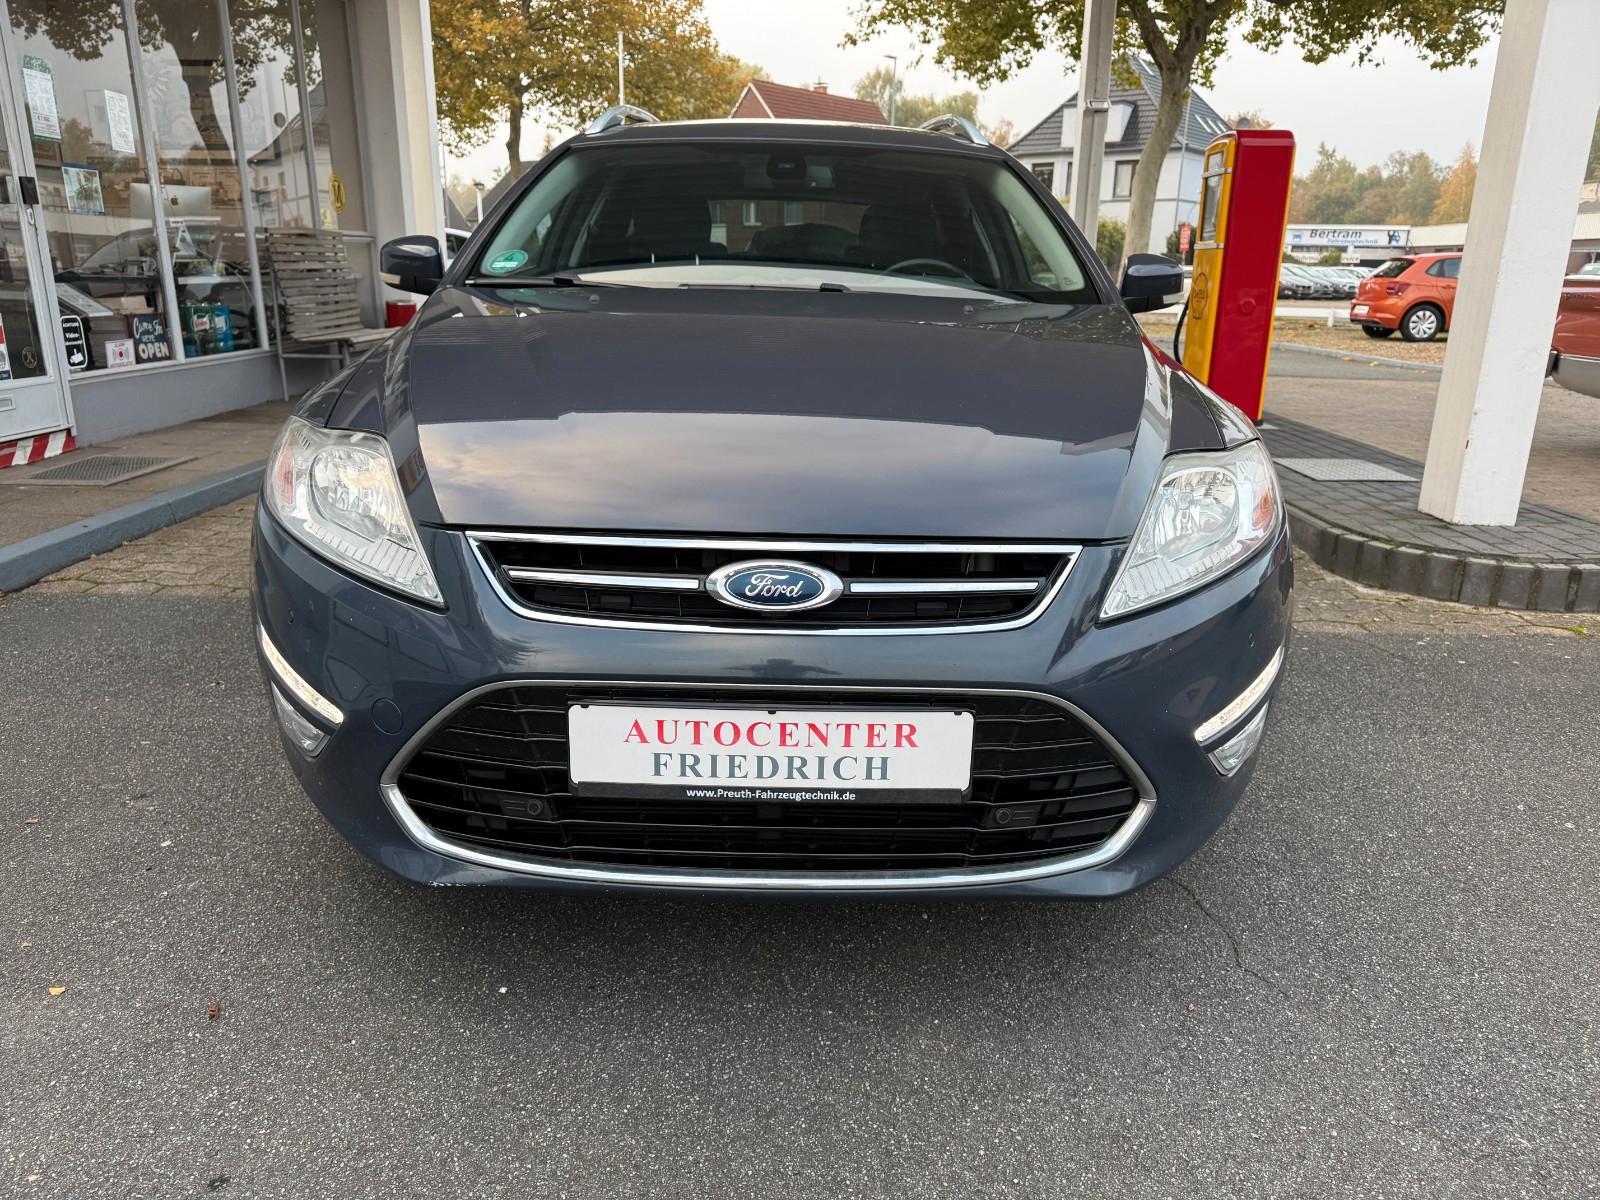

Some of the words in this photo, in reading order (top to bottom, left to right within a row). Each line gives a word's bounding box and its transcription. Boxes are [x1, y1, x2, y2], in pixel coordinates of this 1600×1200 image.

[1309, 229, 1362, 239] Bertram
[133, 317, 152, 339] Come
[138, 342, 170, 359] OPEN
[745, 573, 804, 598] Ford
[623, 718, 920, 749] AUTOCENTER
[651, 752, 891, 782] FRIEDRICH
[686, 788, 856, 802] www.Preuth-Fahrzeugtechnik.de
